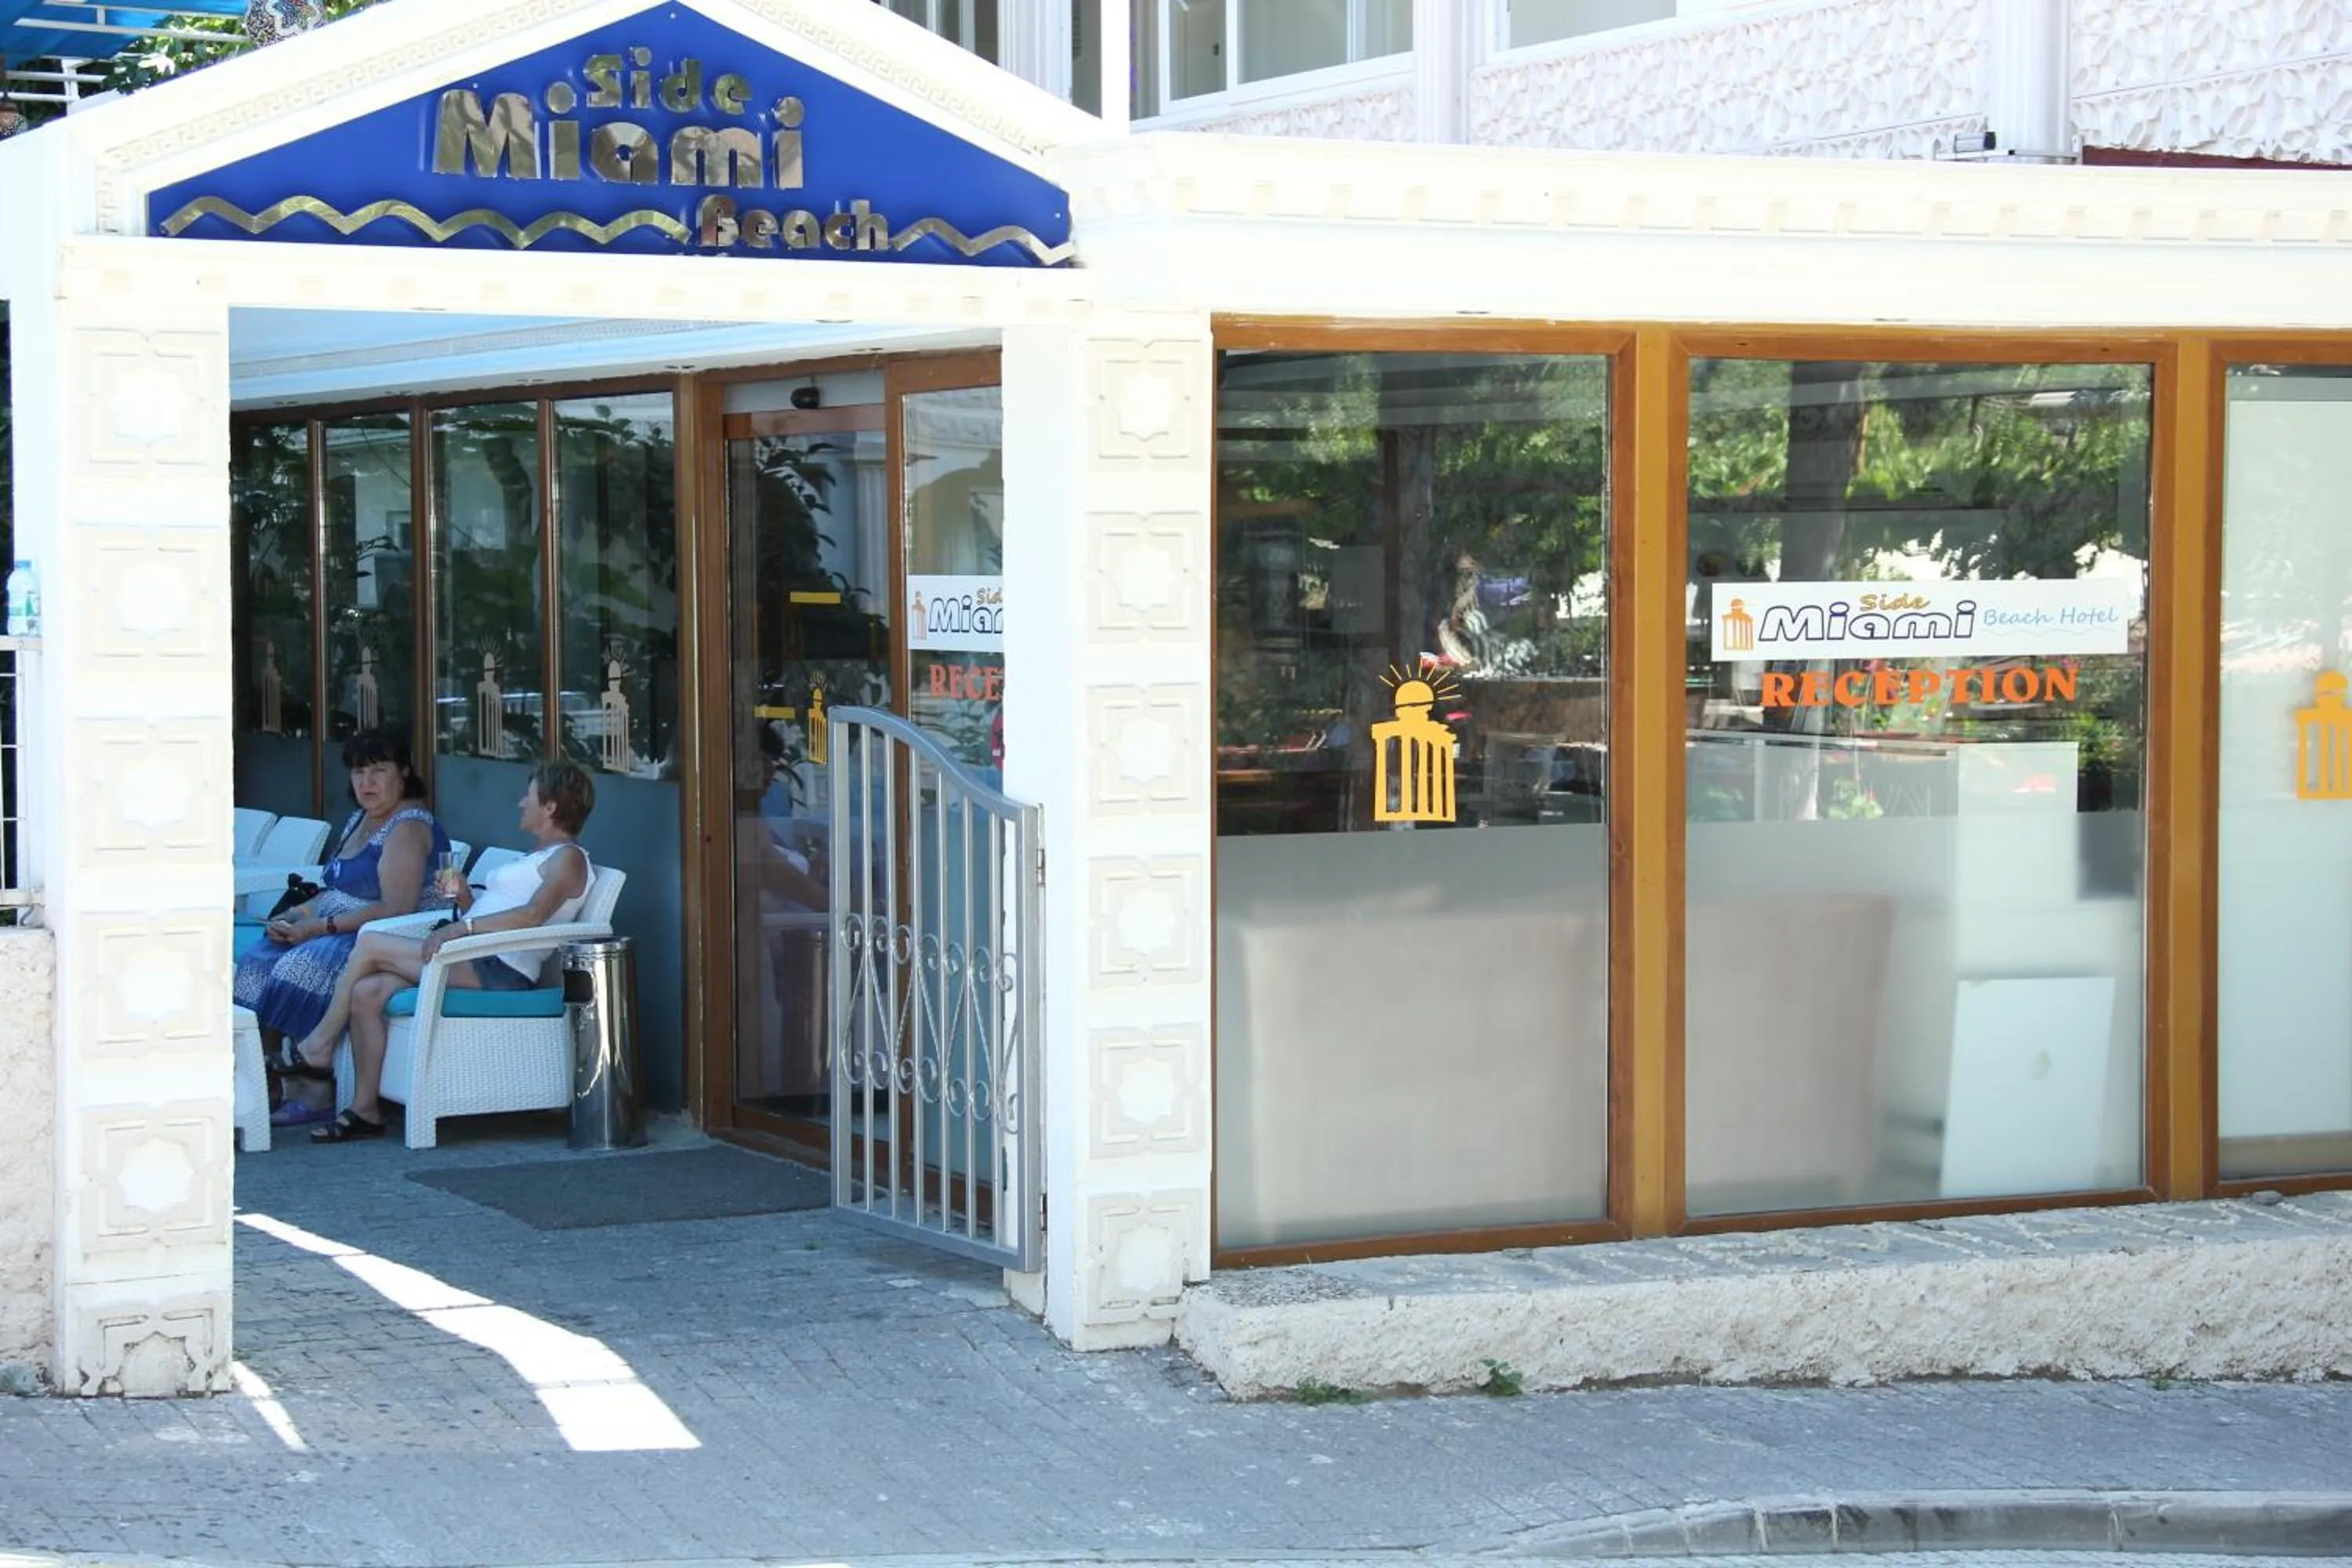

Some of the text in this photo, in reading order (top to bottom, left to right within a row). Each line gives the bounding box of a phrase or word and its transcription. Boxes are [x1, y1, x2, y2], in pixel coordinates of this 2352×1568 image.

[583, 47, 752, 114] Side
[432, 82, 805, 190] Miami
[695, 194, 889, 251] Beach
[1758, 600, 2120, 641] Miami Beach Hotel
[1859, 592, 1931, 612] Side
[1759, 666, 2081, 708] RECEPTION
